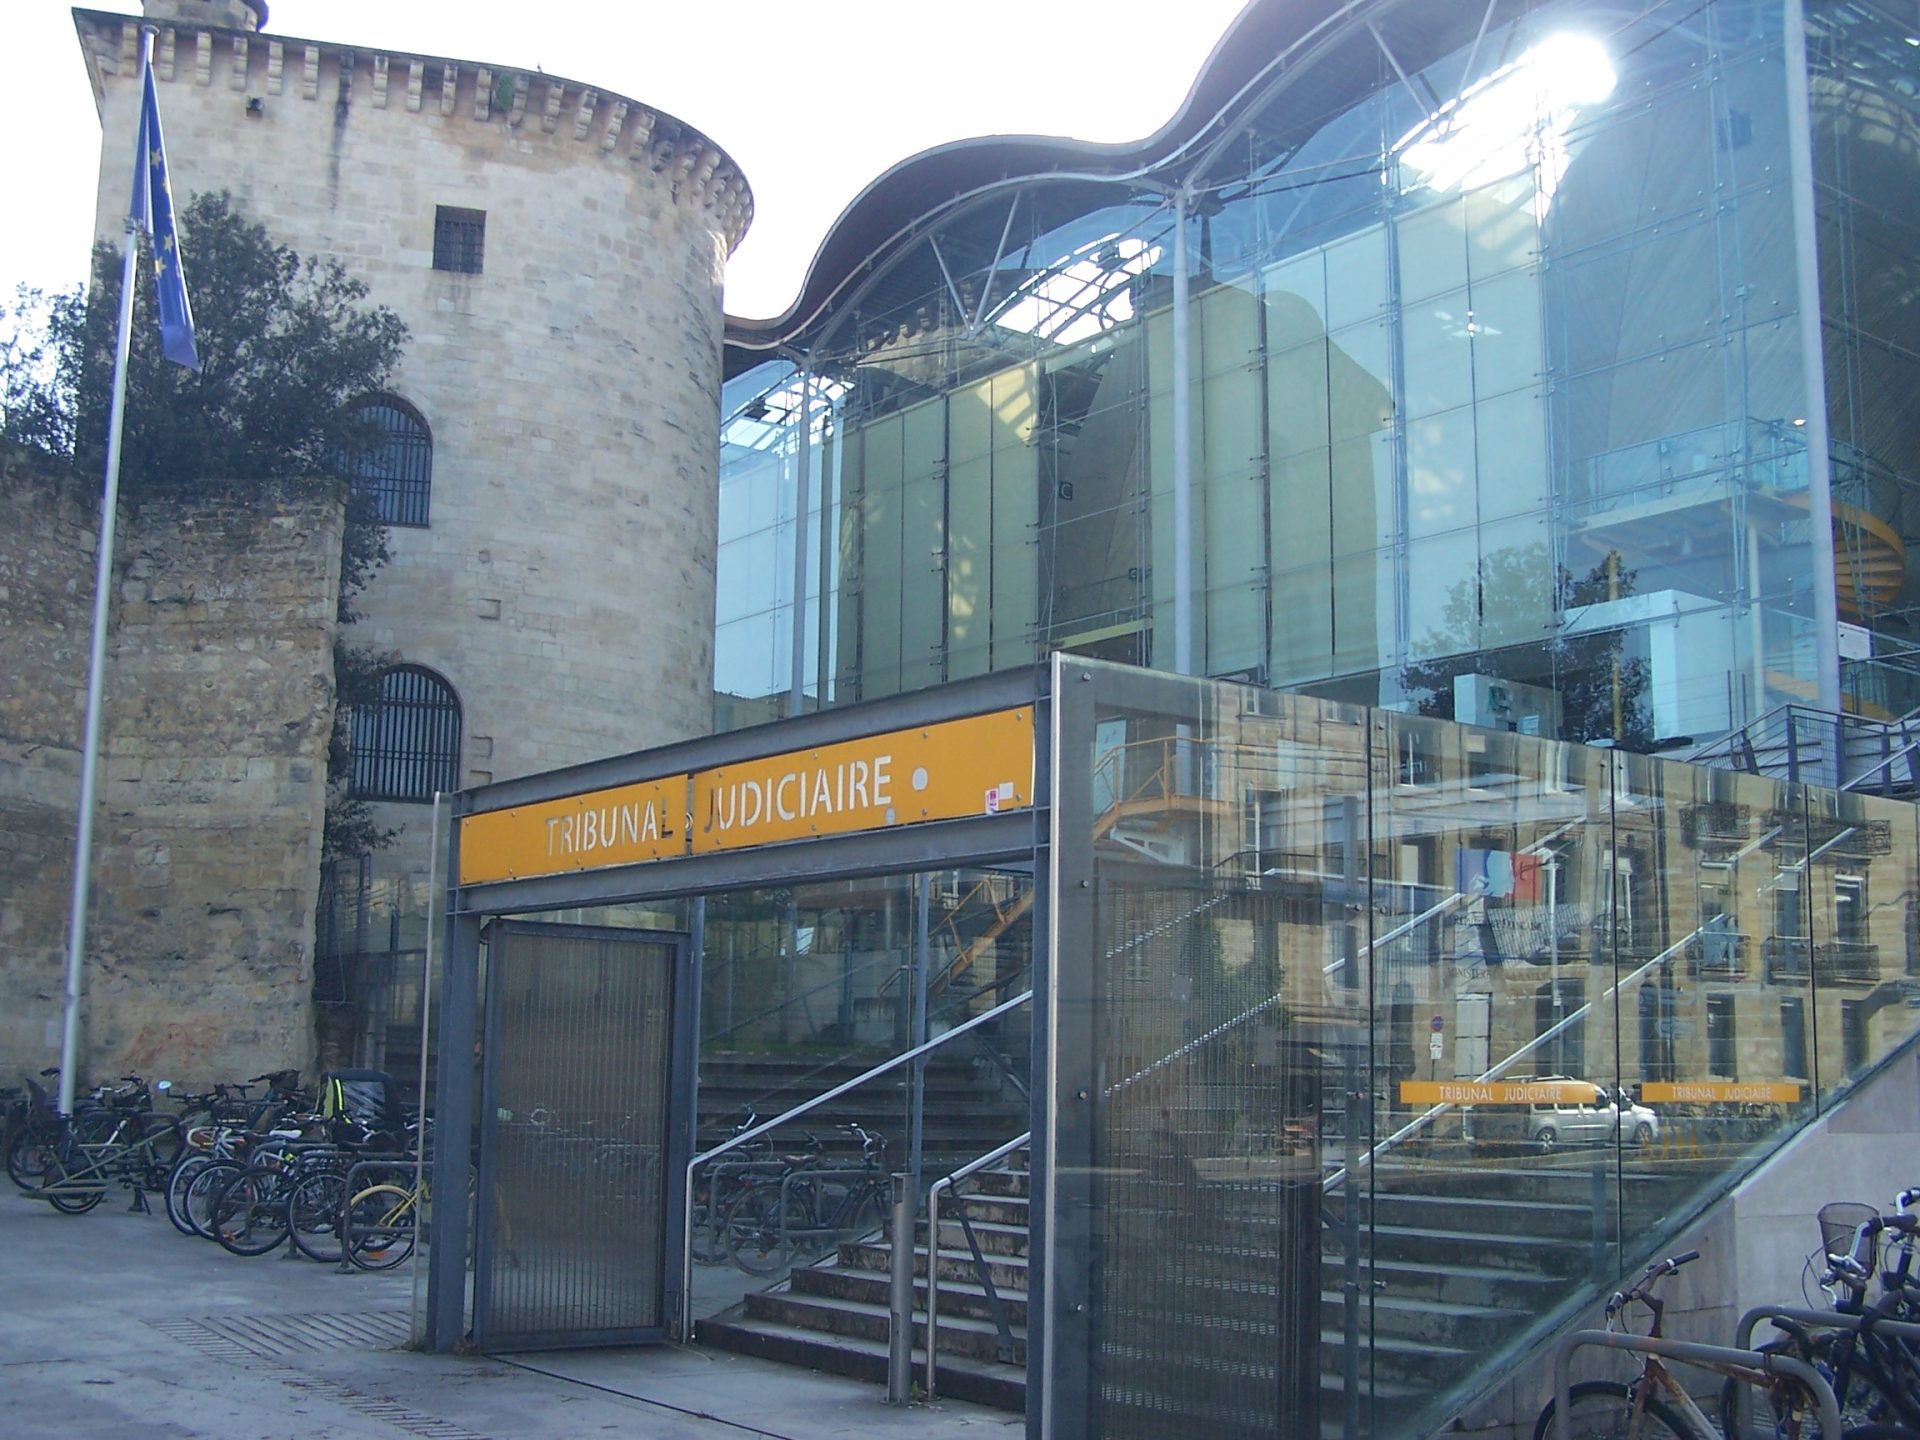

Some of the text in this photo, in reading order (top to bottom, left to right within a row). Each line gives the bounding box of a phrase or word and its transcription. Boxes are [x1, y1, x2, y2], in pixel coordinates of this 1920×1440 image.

[545, 755, 892, 857] TRIBUNAL JUDICIAIRE
[1439, 1085, 1562, 1100] TRIBUNAL JUDICIAIRE
[1672, 1086, 1772, 1099] TRIBUNAL JUDICIAIRE
